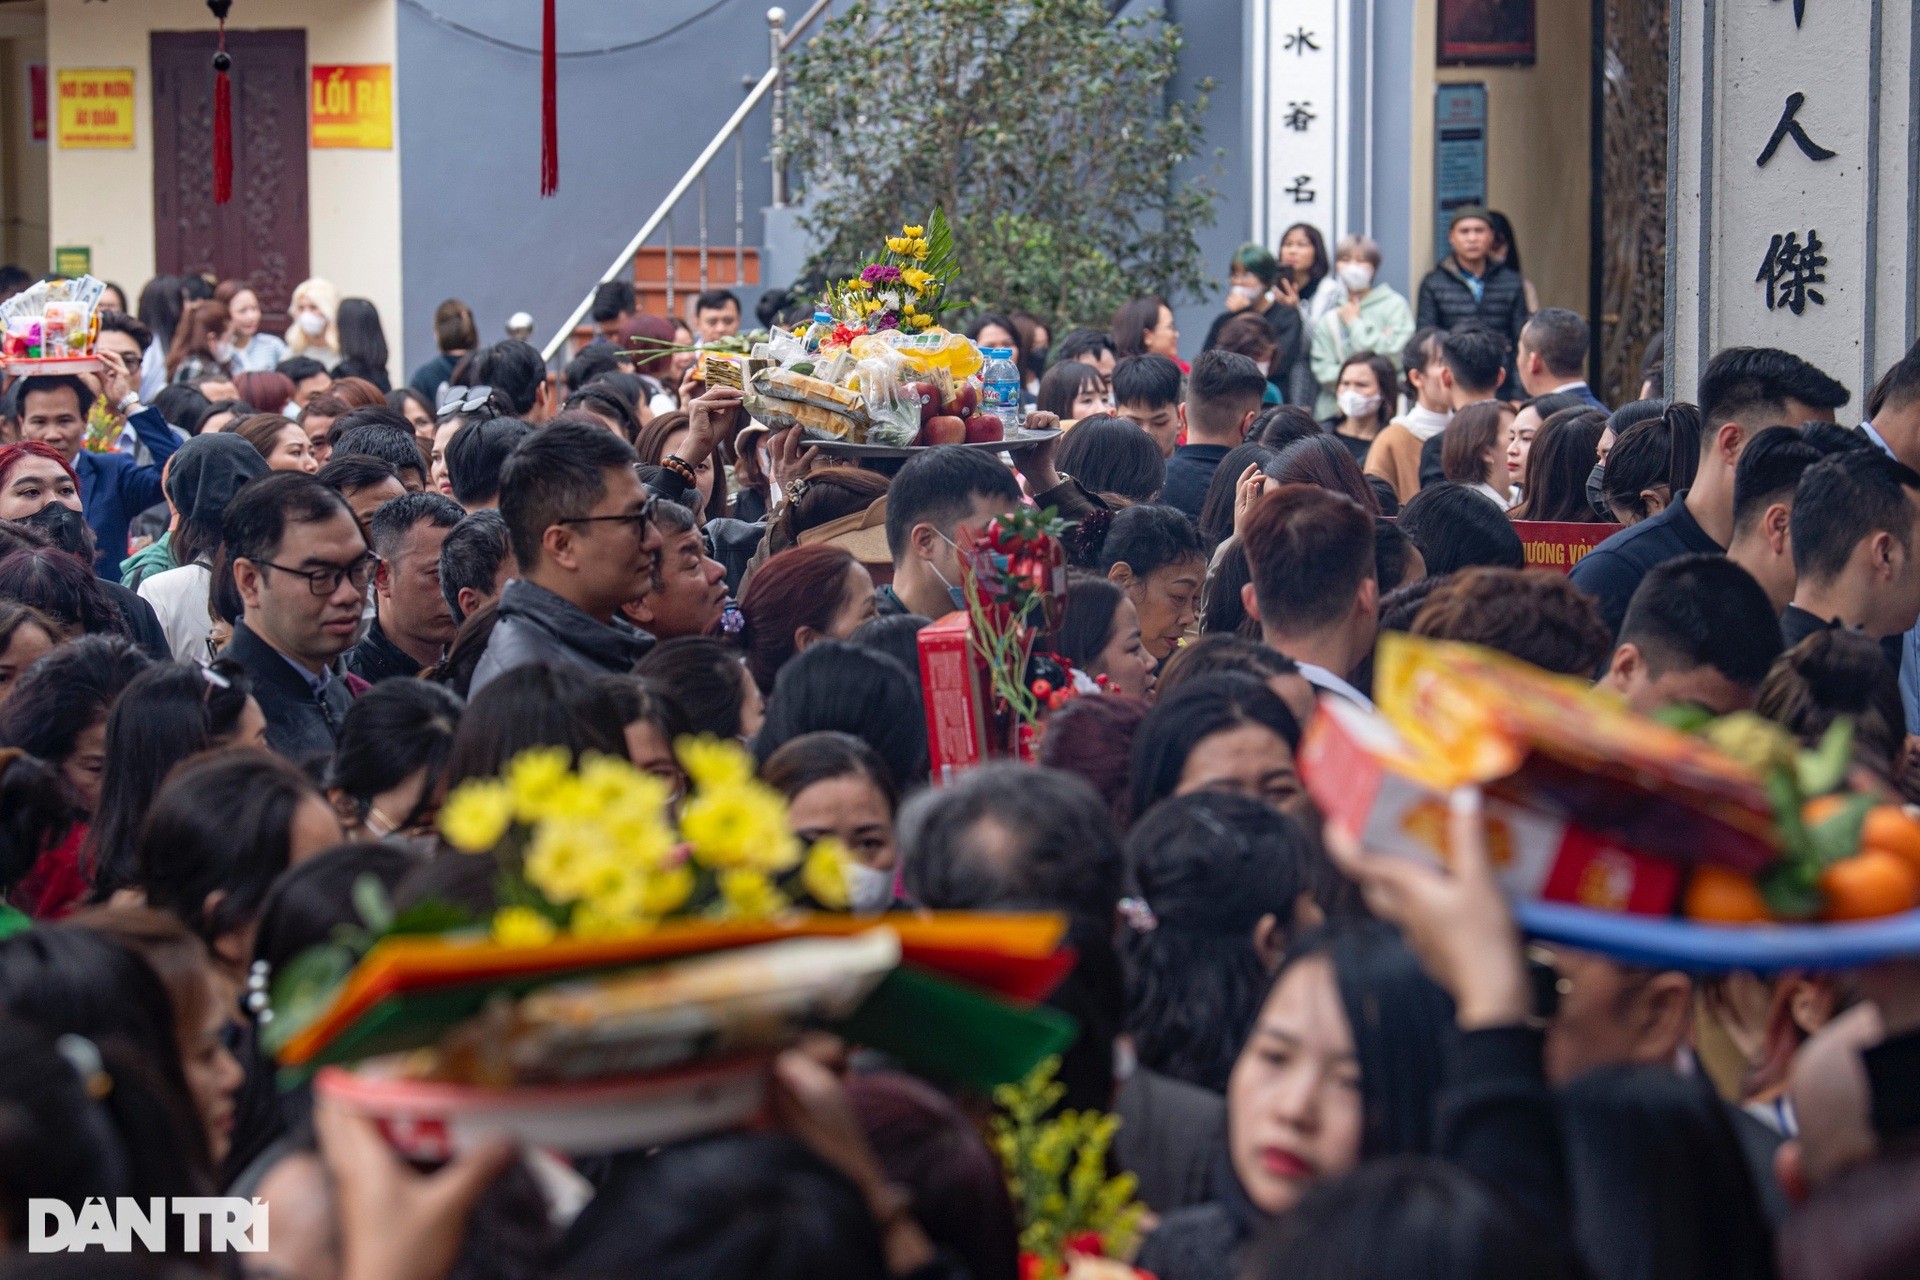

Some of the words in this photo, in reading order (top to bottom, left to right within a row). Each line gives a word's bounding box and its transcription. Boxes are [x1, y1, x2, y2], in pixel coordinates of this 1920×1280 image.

[314, 67, 350, 115] LỐI
[355, 79, 389, 115] RA
[1755, 0, 1837, 315] 人傑
